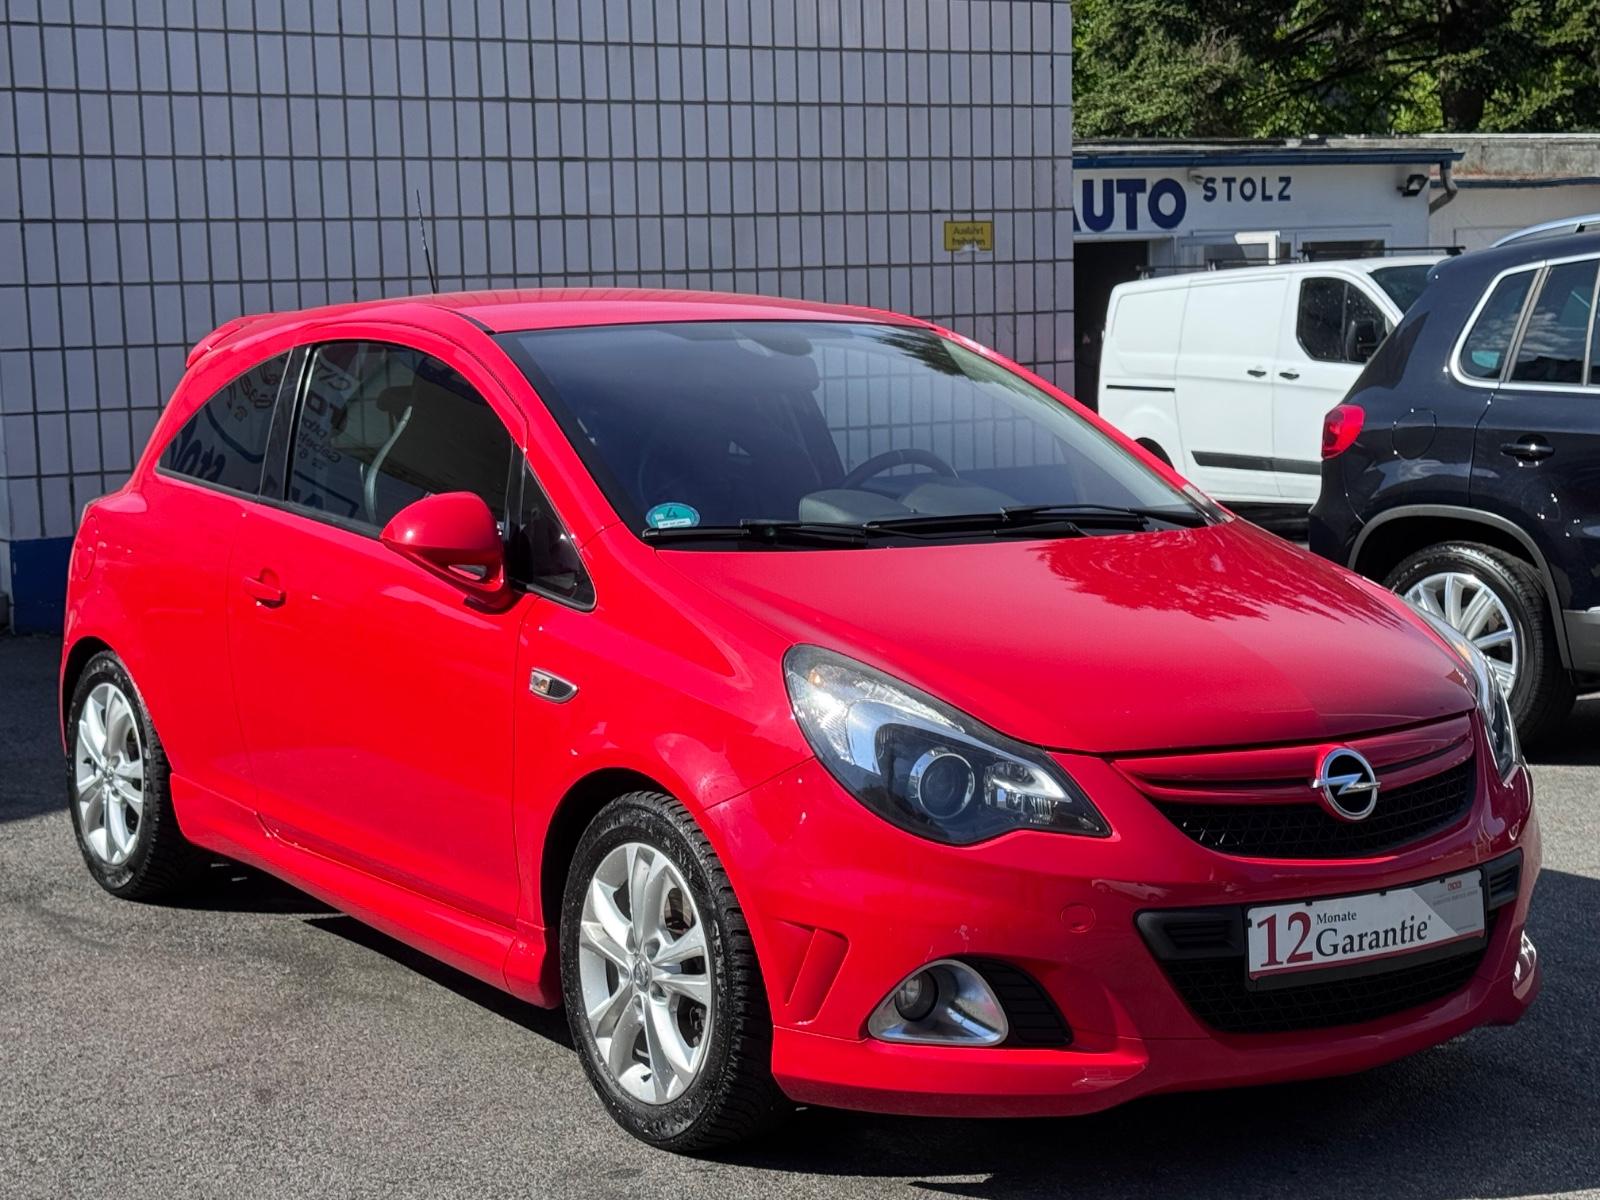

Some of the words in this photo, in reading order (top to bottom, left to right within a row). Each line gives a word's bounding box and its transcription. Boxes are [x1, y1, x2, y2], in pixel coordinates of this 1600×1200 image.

[1073, 178, 1187, 232] UTO
[1203, 176, 1292, 202] STOLZ
[1256, 911, 1313, 967] 12
[1316, 910, 1357, 925] Monate
